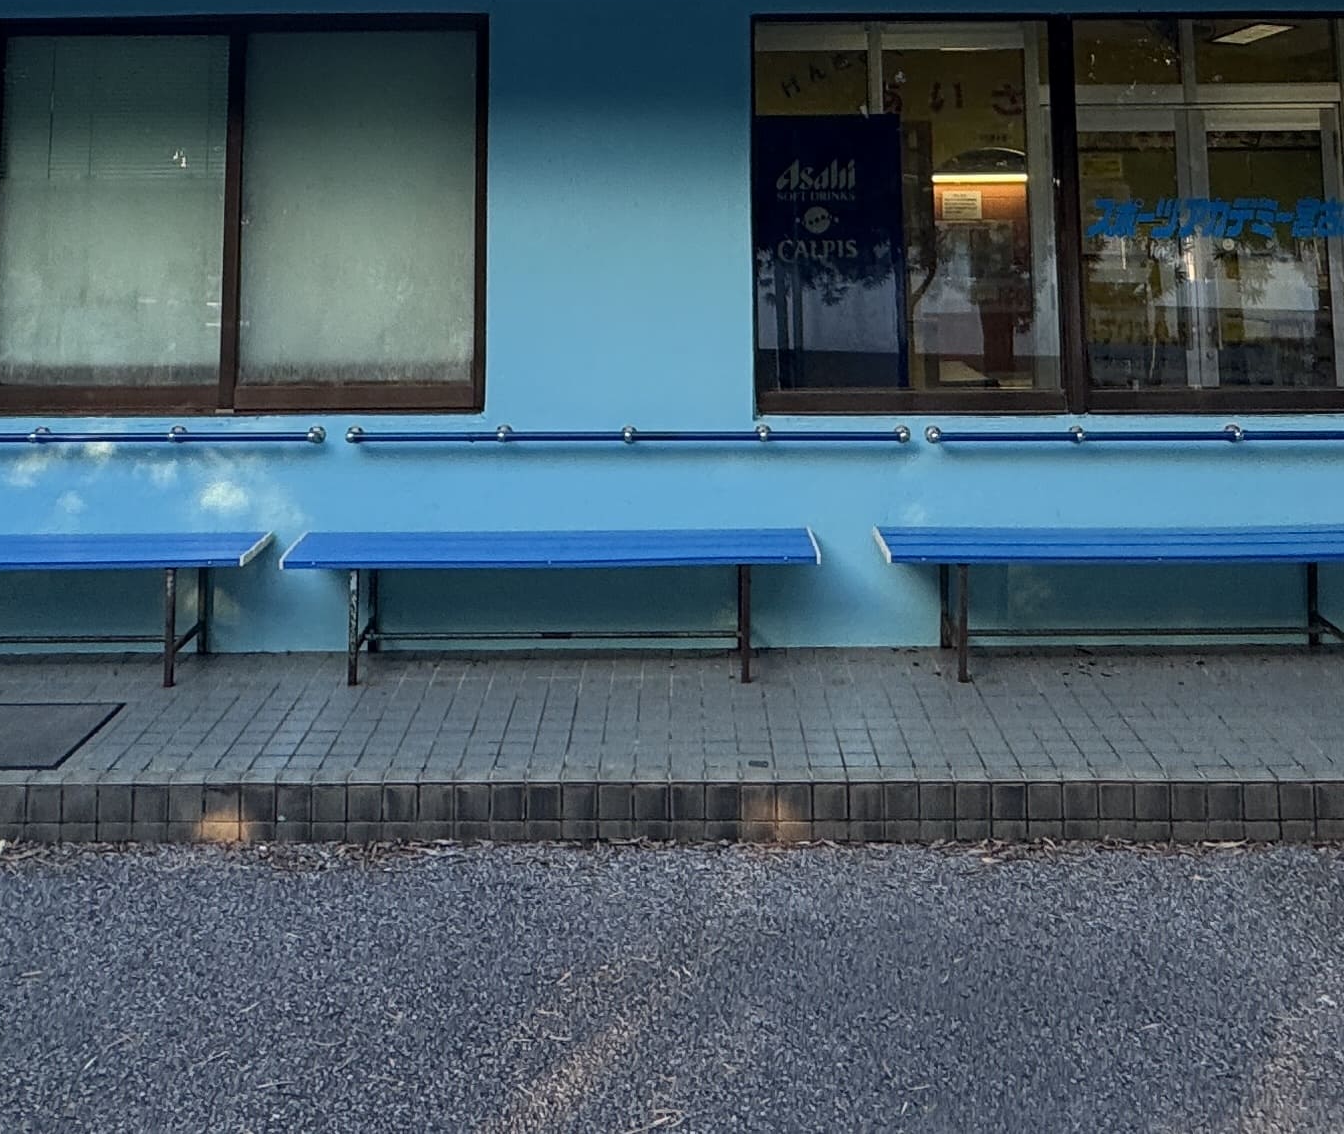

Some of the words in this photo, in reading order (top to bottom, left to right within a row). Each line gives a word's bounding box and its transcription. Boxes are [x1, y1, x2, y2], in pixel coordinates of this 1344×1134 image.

[776, 158, 855, 190] Asahi
[776, 190, 806, 202] SOFT
[810, 190, 855, 202] DRINKS
[777, 239, 858, 263] CALPIS
